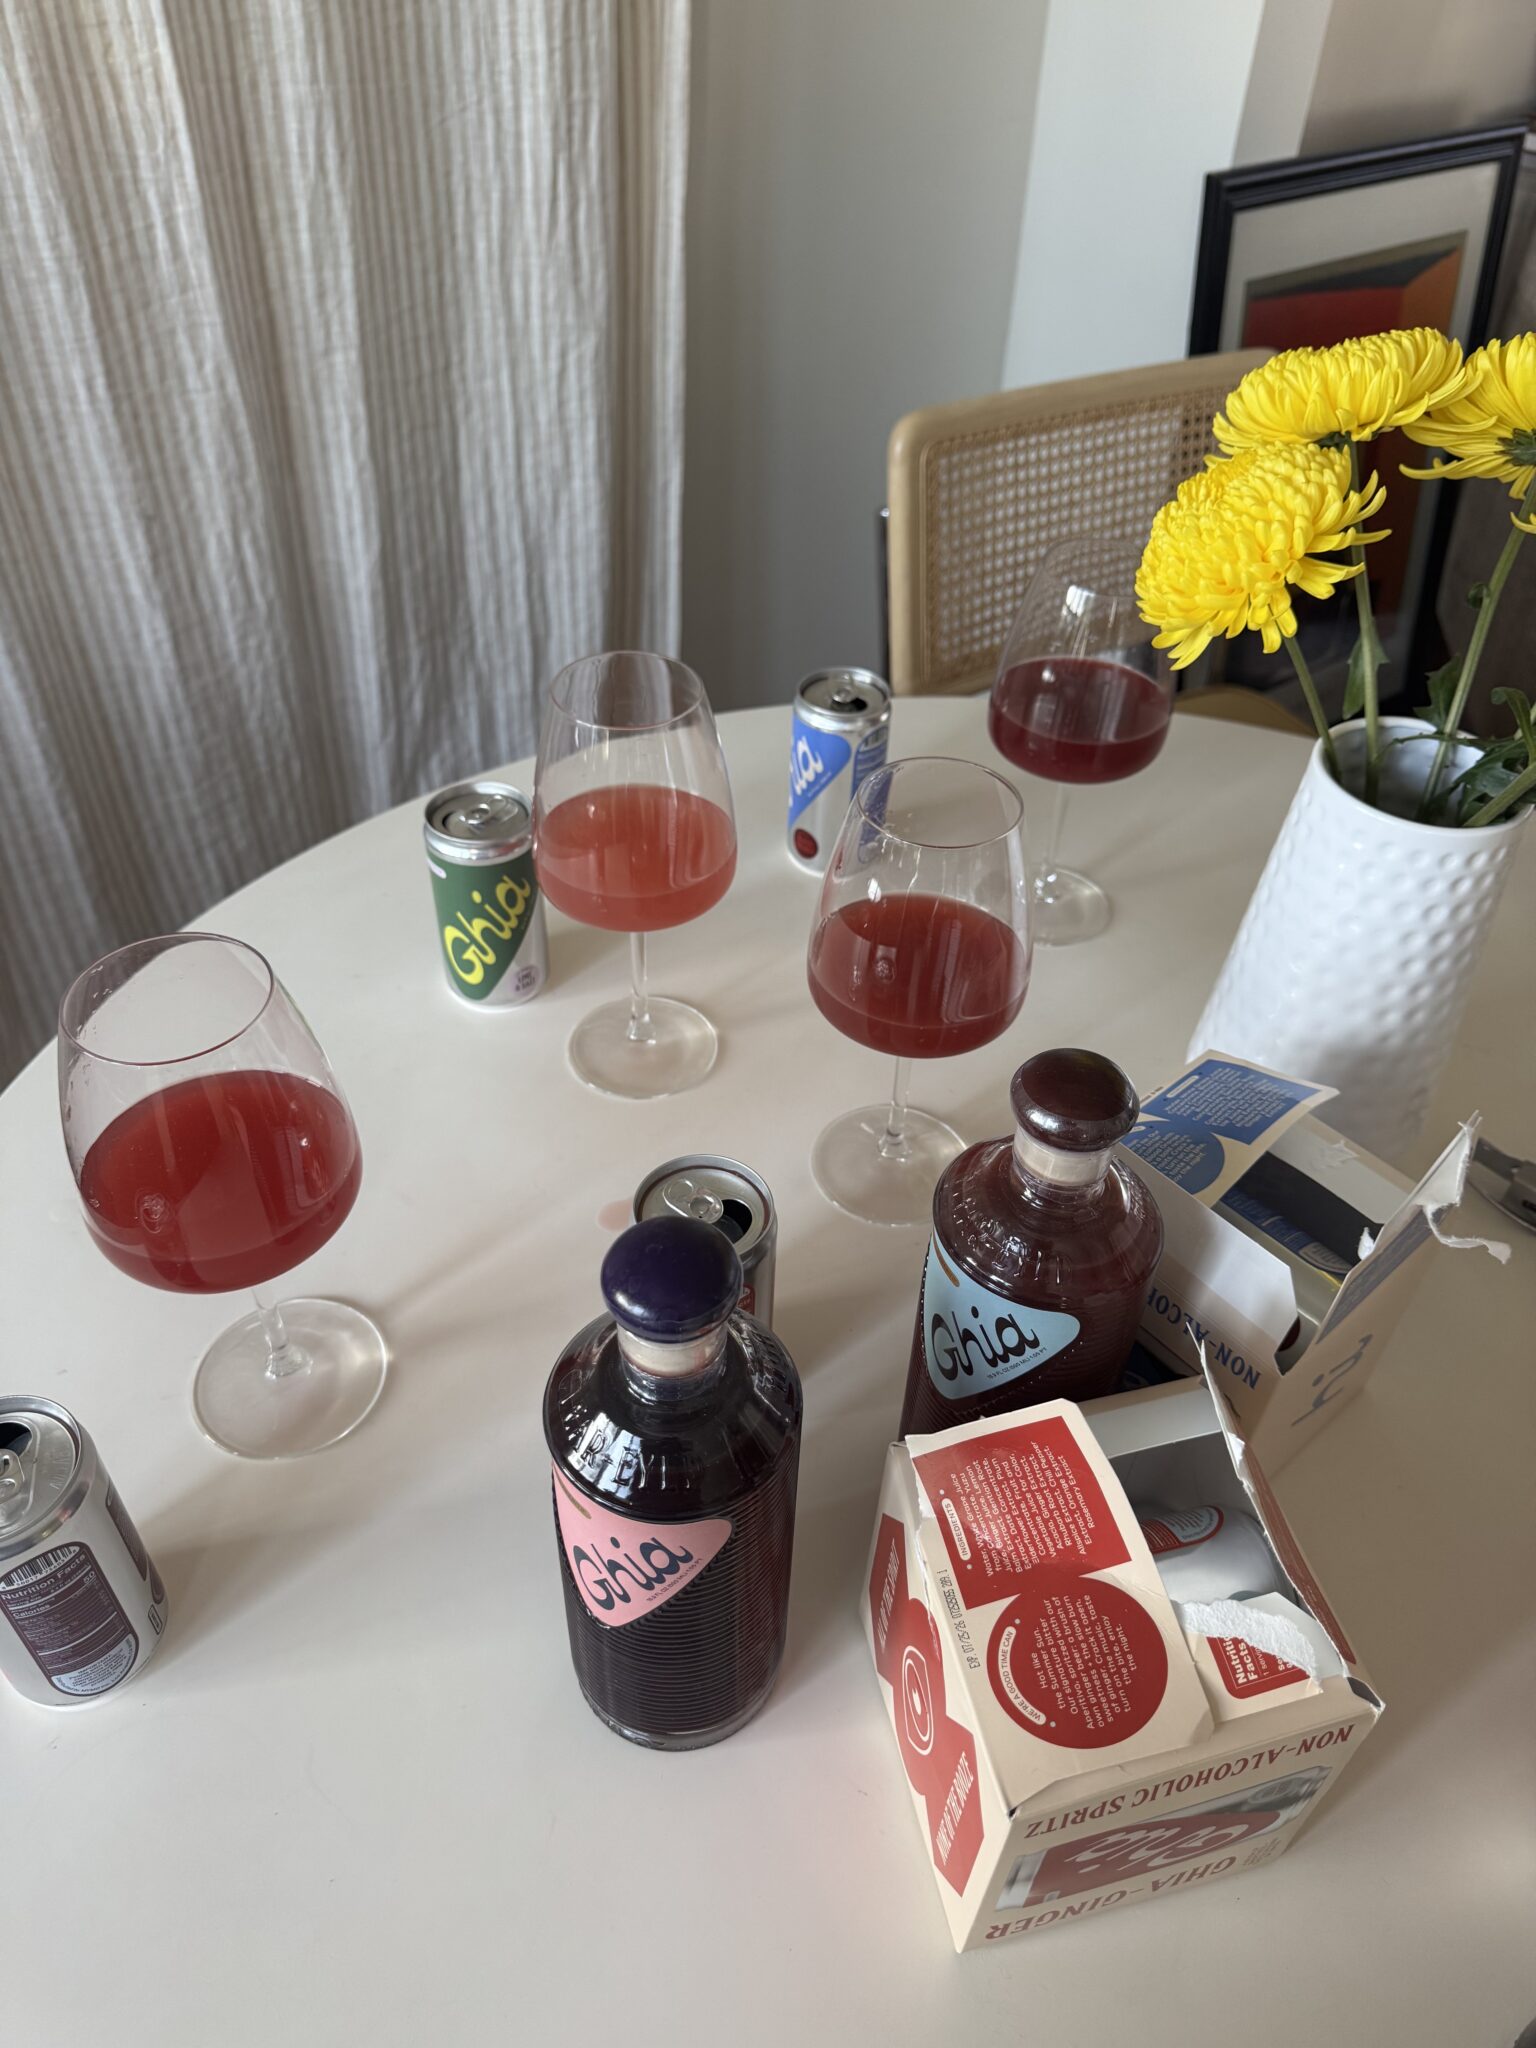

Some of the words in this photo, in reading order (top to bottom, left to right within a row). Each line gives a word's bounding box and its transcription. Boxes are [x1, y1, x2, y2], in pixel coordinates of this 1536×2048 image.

[444, 875, 530, 985] Ghia
[931, 1306, 1040, 1381] Ghia
[1030, 1441, 1048, 1468] Pepper
[965, 1465, 981, 1494] Lemon
[972, 1460, 984, 1480] Root
[991, 1458, 1003, 1479] Plum
[1001, 1461, 1012, 1477] and
[1057, 1455, 1075, 1484] Extract
[950, 1473, 963, 1493] Juice
[959, 1472, 970, 1493] Yuzu
[1009, 1479, 1021, 1499] Fruit
[1019, 1479, 1028, 1491] for
[1059, 1478, 1076, 1509] Orange
[960, 1496, 973, 1520] Grape
[982, 1481, 998, 1514] Gentian
[1025, 1492, 1038, 1513] Juice
[1034, 1492, 1049, 1518] Ginger
[1043, 1489, 1055, 1508] Root
[1073, 1487, 1094, 1527] Rosemary
[945, 1503, 967, 1555] INGREDIENTS
[988, 1521, 1002, 1548] Ginger
[1005, 1514, 1017, 1534] Date
[1035, 1515, 1055, 1556] Vegetable
[1053, 1510, 1071, 1545] Rhubarb
[1069, 1524, 1085, 1554] Allspice
[991, 1550, 1001, 1570] from
[1, 1578, 55, 1600] Nutrition
[57, 1554, 86, 1578] Facts
[573, 1536, 694, 1611] Ghia
[1043, 1599, 1053, 1614] our
[1051, 1596, 1060, 1605] of
[1063, 1595, 1075, 1617] burn
[1076, 1598, 1088, 1624] open,
[1084, 1595, 1097, 1619] taste
[1039, 1618, 1053, 1645] bitter
[1049, 1616, 1061, 1637] with
[1057, 1607, 1071, 1634] brush
[1071, 1619, 1083, 1640] slow
[1084, 1626, 1092, 1634] it
[1101, 1615, 1115, 1640] enjoy
[1004, 1631, 1013, 1646] CAN
[1033, 1627, 1044, 1647] Sun.
[1095, 1622, 1109, 1652] music,
[1115, 1624, 1129, 1651] night.
[1031, 1652, 1040, 1668] like
[1057, 1639, 1076, 1678] spritzed
[1071, 1645, 1084, 1670] beer:
[1080, 1642, 1090, 1659] the
[1088, 1636, 1102, 1663] Crack
[1113, 1643, 1124, 1665] bite,
[1238, 1642, 1259, 1681] Facts
[1040, 1650, 1058, 1689] Summer
[1050, 1647, 1071, 1693] signature
[1106, 1655, 1116, 1672] the
[1126, 1654, 1136, 1670] the
[1002, 1670, 1015, 1693] GOOD
[1037, 1670, 1047, 1688] Hot
[1080, 1672, 1096, 1703] ginger
[1100, 1666, 1116, 1699] ginger.
[1113, 1674, 1121, 1687] on
[1121, 1667, 1131, 1684] the
[1055, 1692, 1065, 1708] the
[1067, 1696, 1078, 1714] Our
[1074, 1681, 1094, 1728] Aperitivo,
[1090, 1669, 1113, 1721] sweetness
[1111, 1702, 1120, 1712] of
[1118, 1689, 1130, 1711] turn
[1018, 1699, 1040, 1720] WE'RE
[1092, 1705, 1104, 1727] own
[1131, 1723, 1355, 1805] NON-ALCOHOLIC
[1024, 1794, 1127, 1839] SPRITZ
[1064, 1823, 1249, 1874] Ghia
